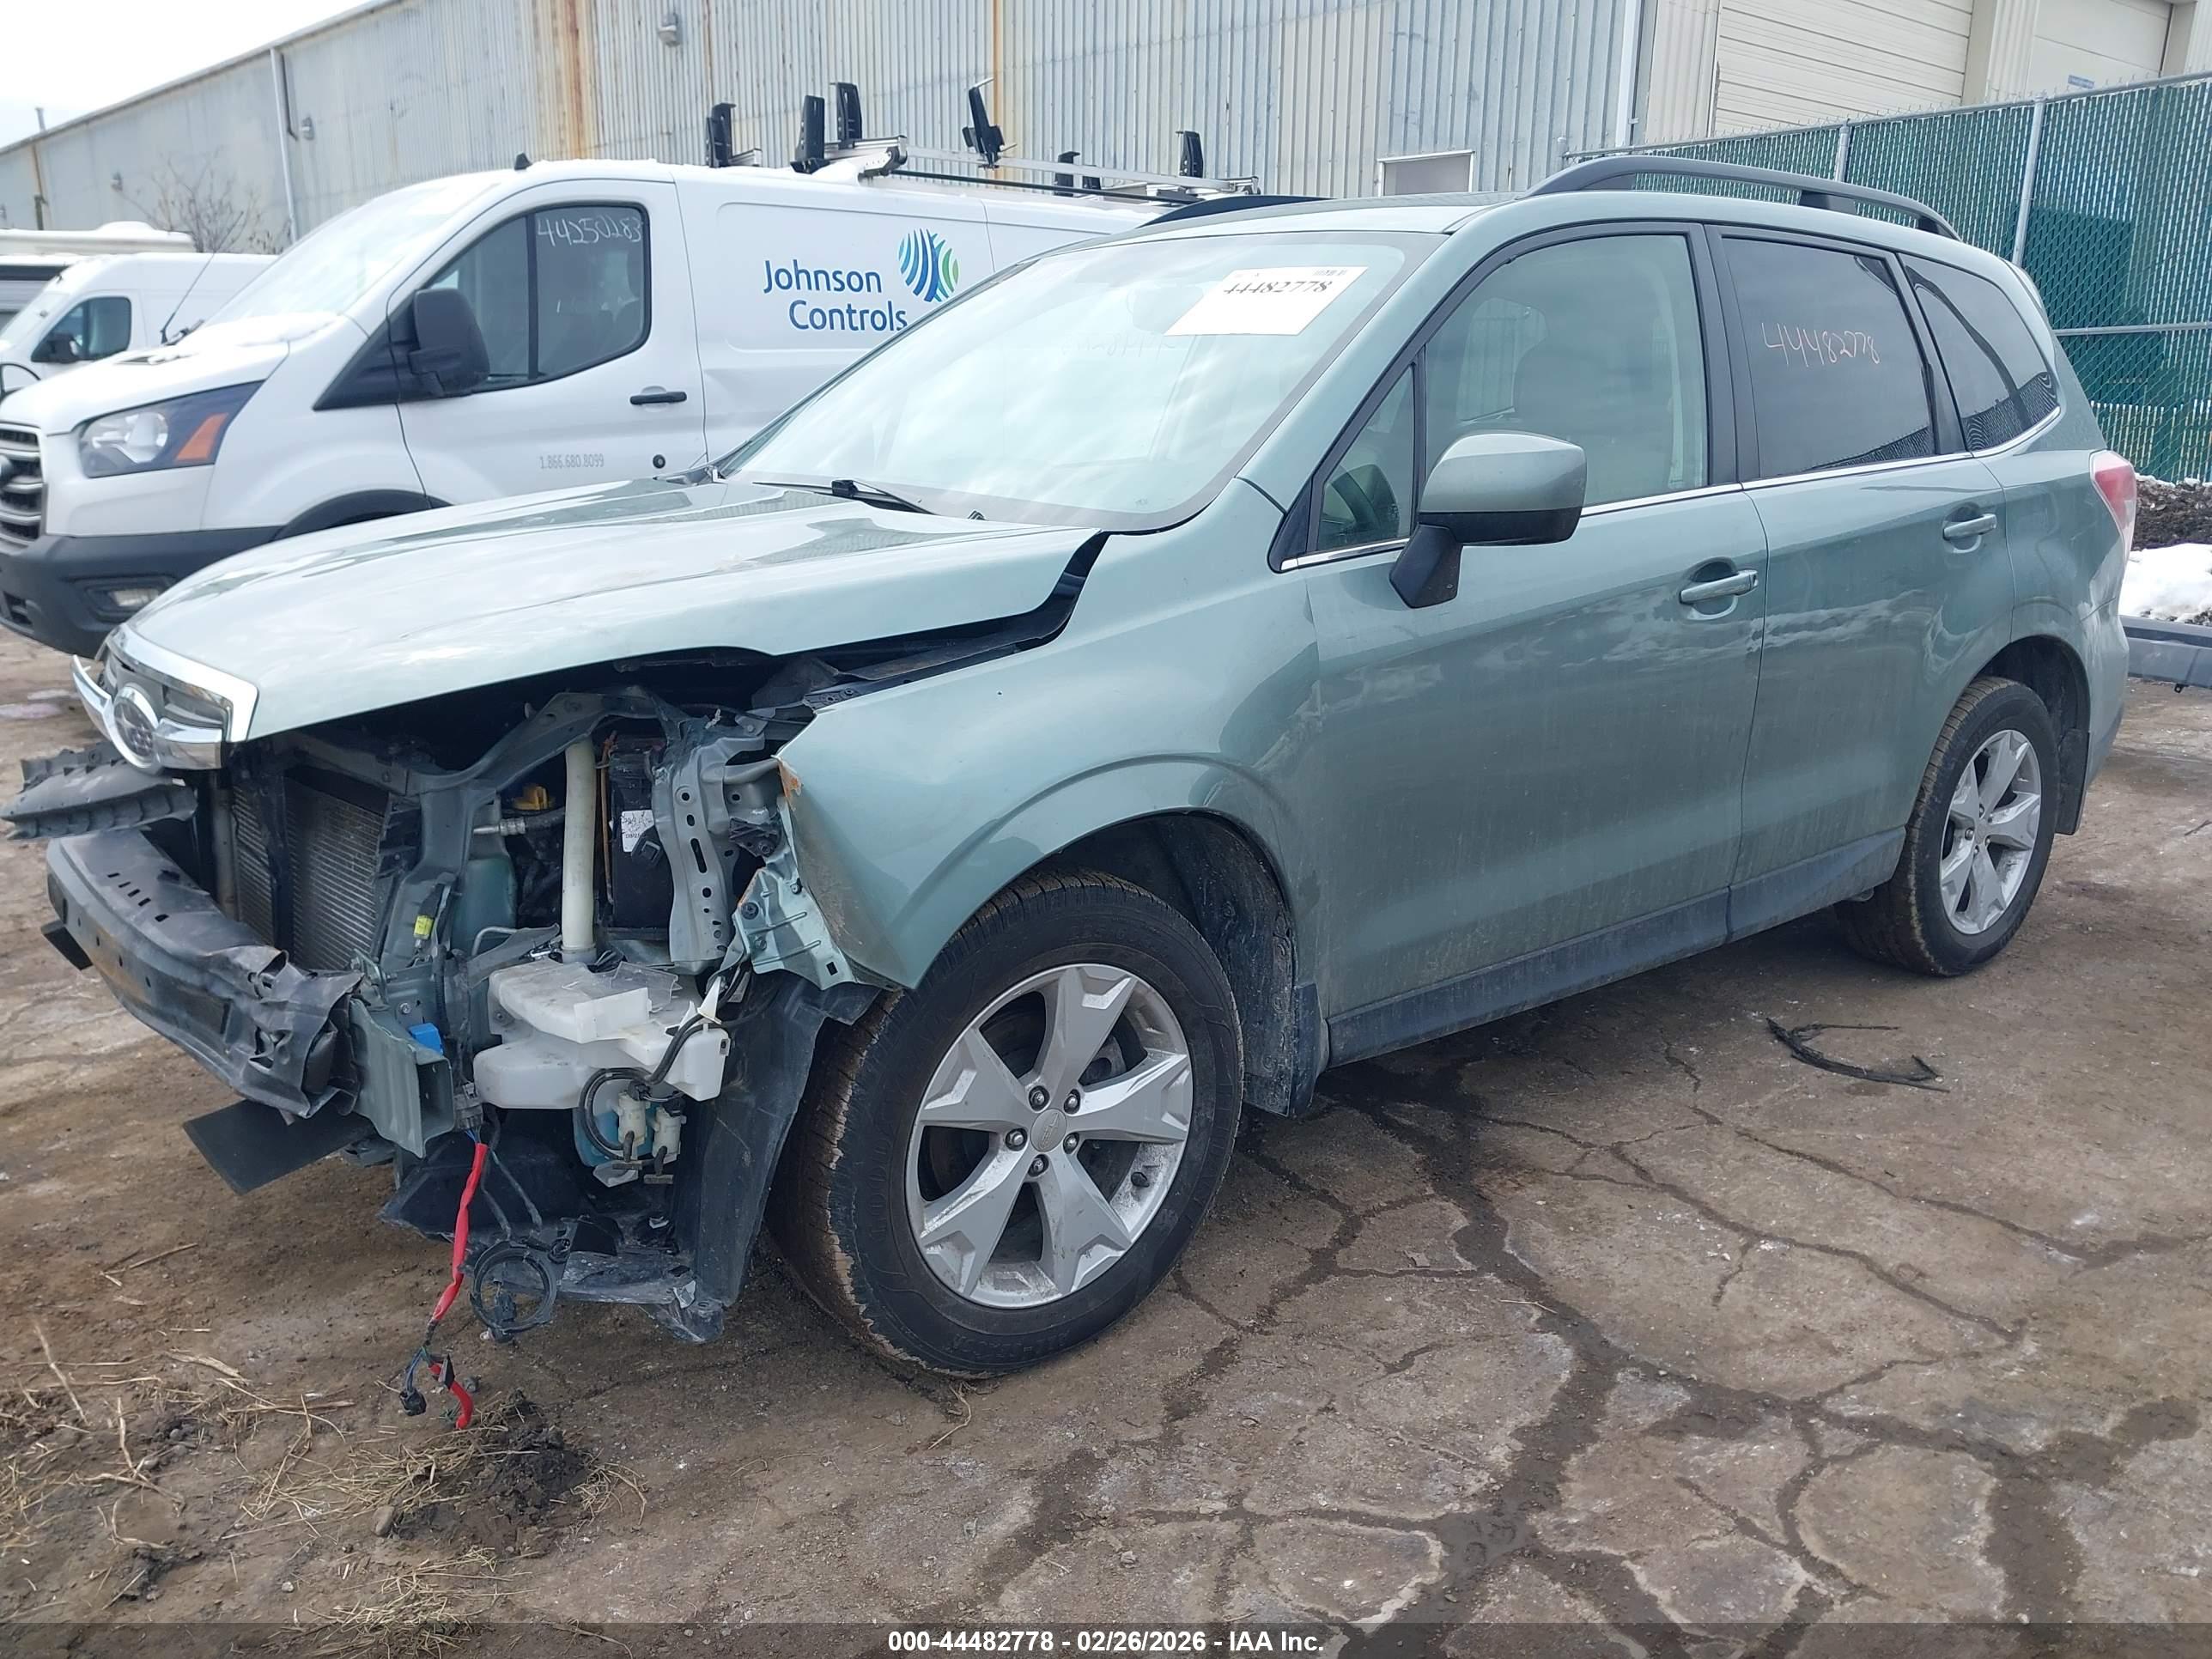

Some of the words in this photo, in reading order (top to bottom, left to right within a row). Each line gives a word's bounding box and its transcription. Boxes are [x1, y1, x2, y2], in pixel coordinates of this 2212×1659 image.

[763, 259, 882, 293] Johnson
[1223, 281, 1334, 294] 44482778
[789, 301, 908, 331] Controls
[1761, 322, 1881, 368] 44482778
[539, 453, 605, 470] 1.866.680.8099
